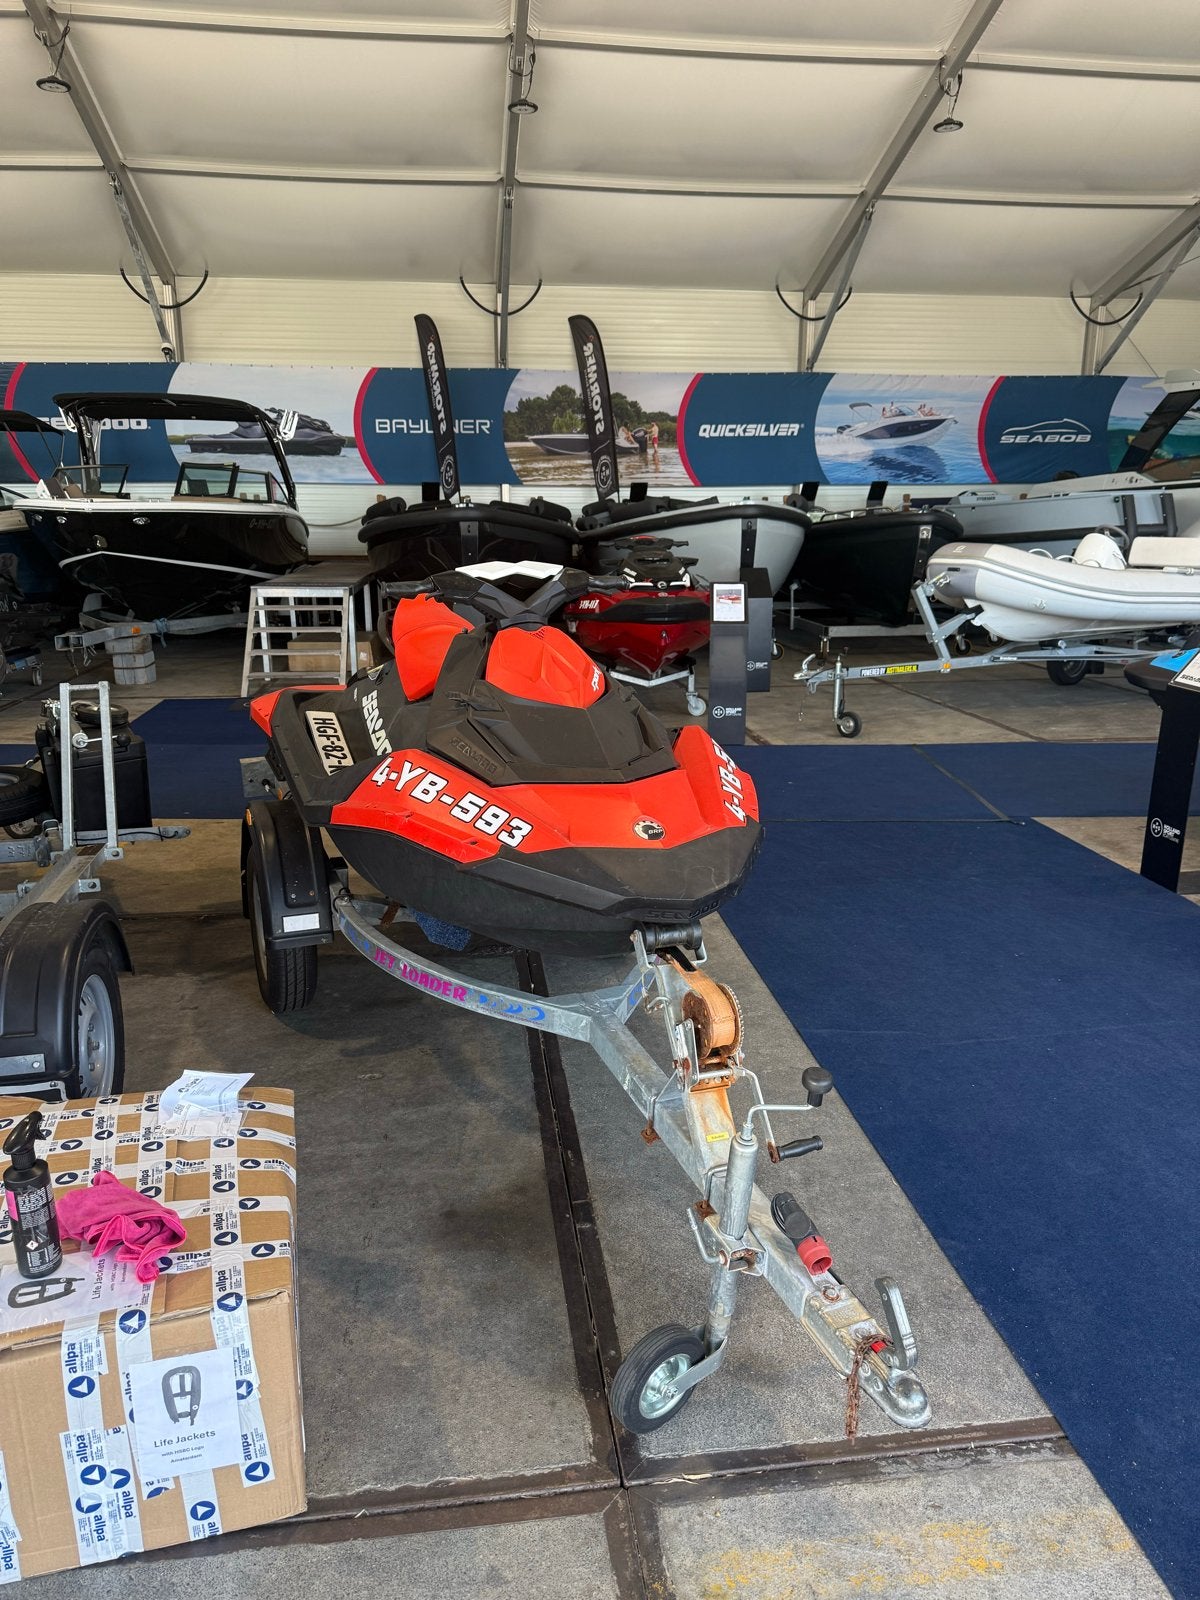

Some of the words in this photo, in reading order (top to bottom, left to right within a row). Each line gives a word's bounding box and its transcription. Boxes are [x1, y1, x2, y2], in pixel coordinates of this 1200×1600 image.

[375, 418, 491, 434] BAYLNER
[698, 423, 800, 438] QUICKSILVER
[1000, 434, 1092, 443] SEABOB
[710, 737, 747, 824] 4-YB-5
[371, 756, 534, 848] 4-YB-593
[139, 1169, 151, 1186] allpa
[213, 1164, 224, 1180] allpa
[213, 1212, 224, 1232] allpa
[176, 1250, 211, 1262] allpa
[95, 1258, 106, 1286] Jackets
[216, 1269, 228, 1293] allpa
[92, 1284, 101, 1300] Life
[65, 1342, 78, 1374] allpa
[76, 1434, 88, 1463] allpa
[154, 1436, 174, 1448] Life
[176, 1430, 216, 1444] Jackets
[241, 1433, 252, 1462] allpa
[170, 1454, 203, 1464] Amsterdam
[122, 1490, 134, 1519] allpa
[94, 1514, 106, 1542] allpa
